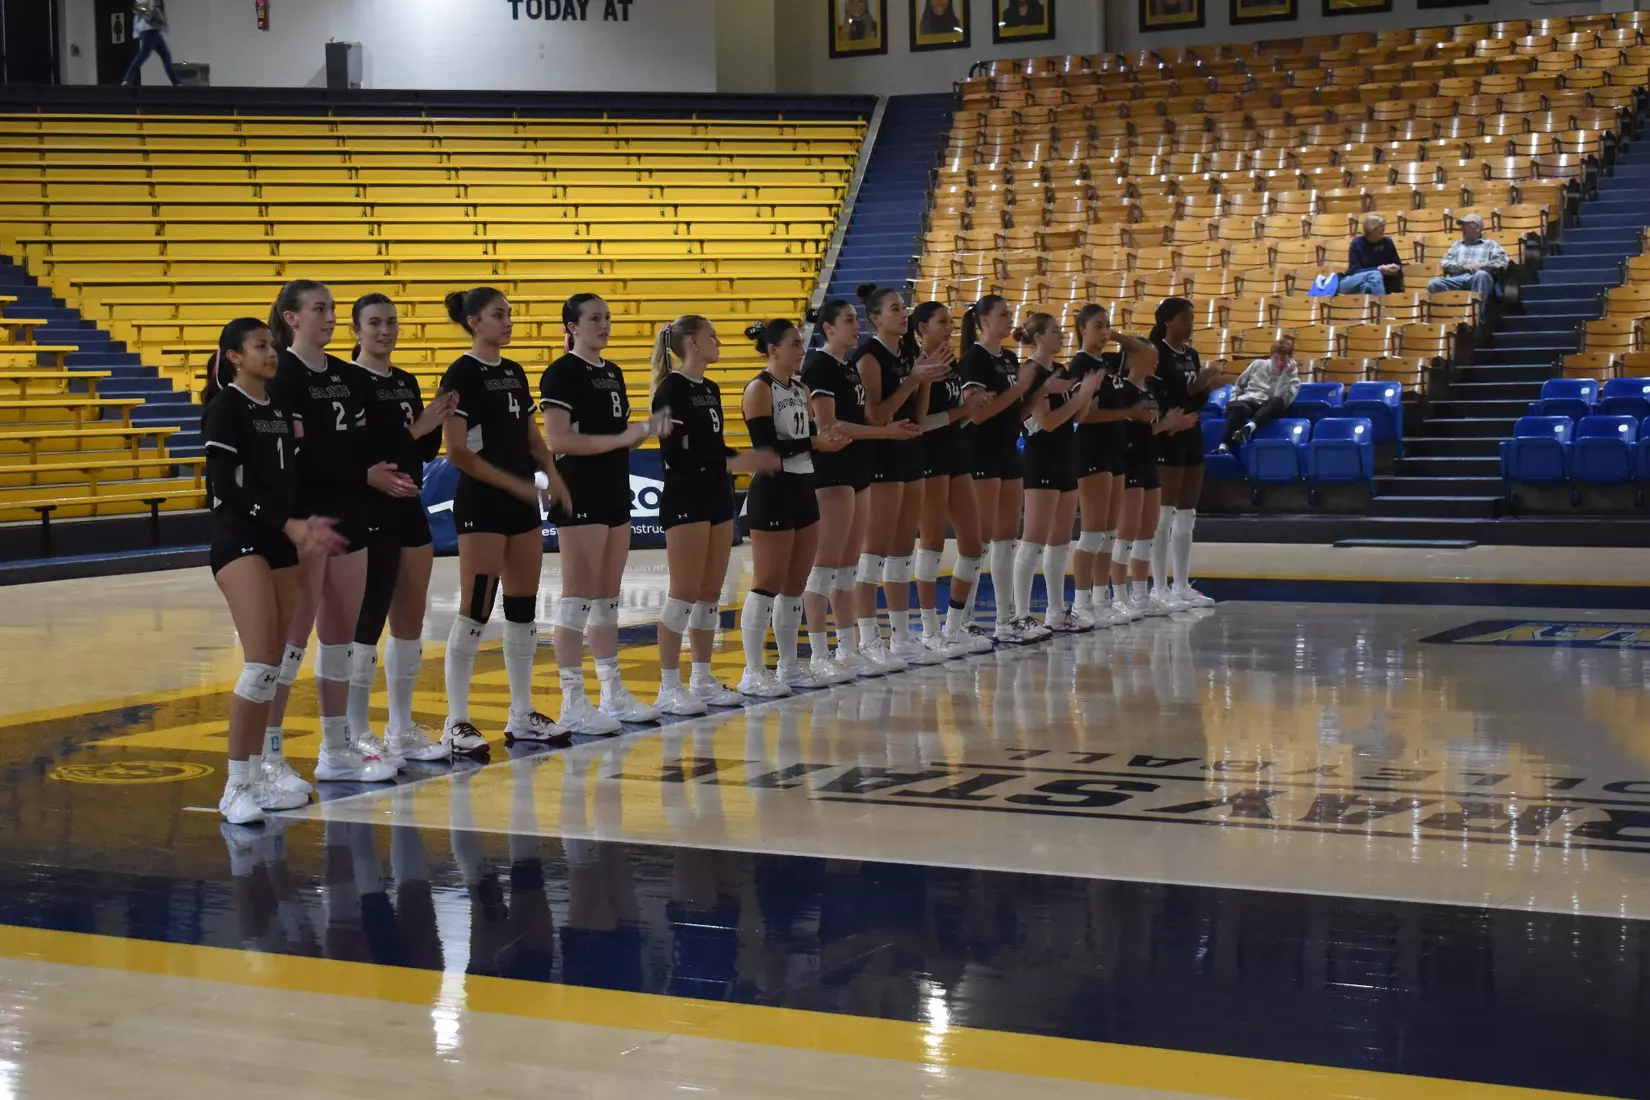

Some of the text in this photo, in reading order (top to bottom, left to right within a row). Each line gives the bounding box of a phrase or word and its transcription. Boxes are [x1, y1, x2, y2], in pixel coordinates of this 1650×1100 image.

[507, 0, 633, 22] TODAY AT
[331, 401, 349, 431] 2
[400, 402, 414, 428] 3
[507, 391, 521, 420] 4
[610, 391, 623, 418] 8
[708, 407, 721, 434] 9
[793, 412, 805, 436] 11
[277, 437, 286, 470] 1
